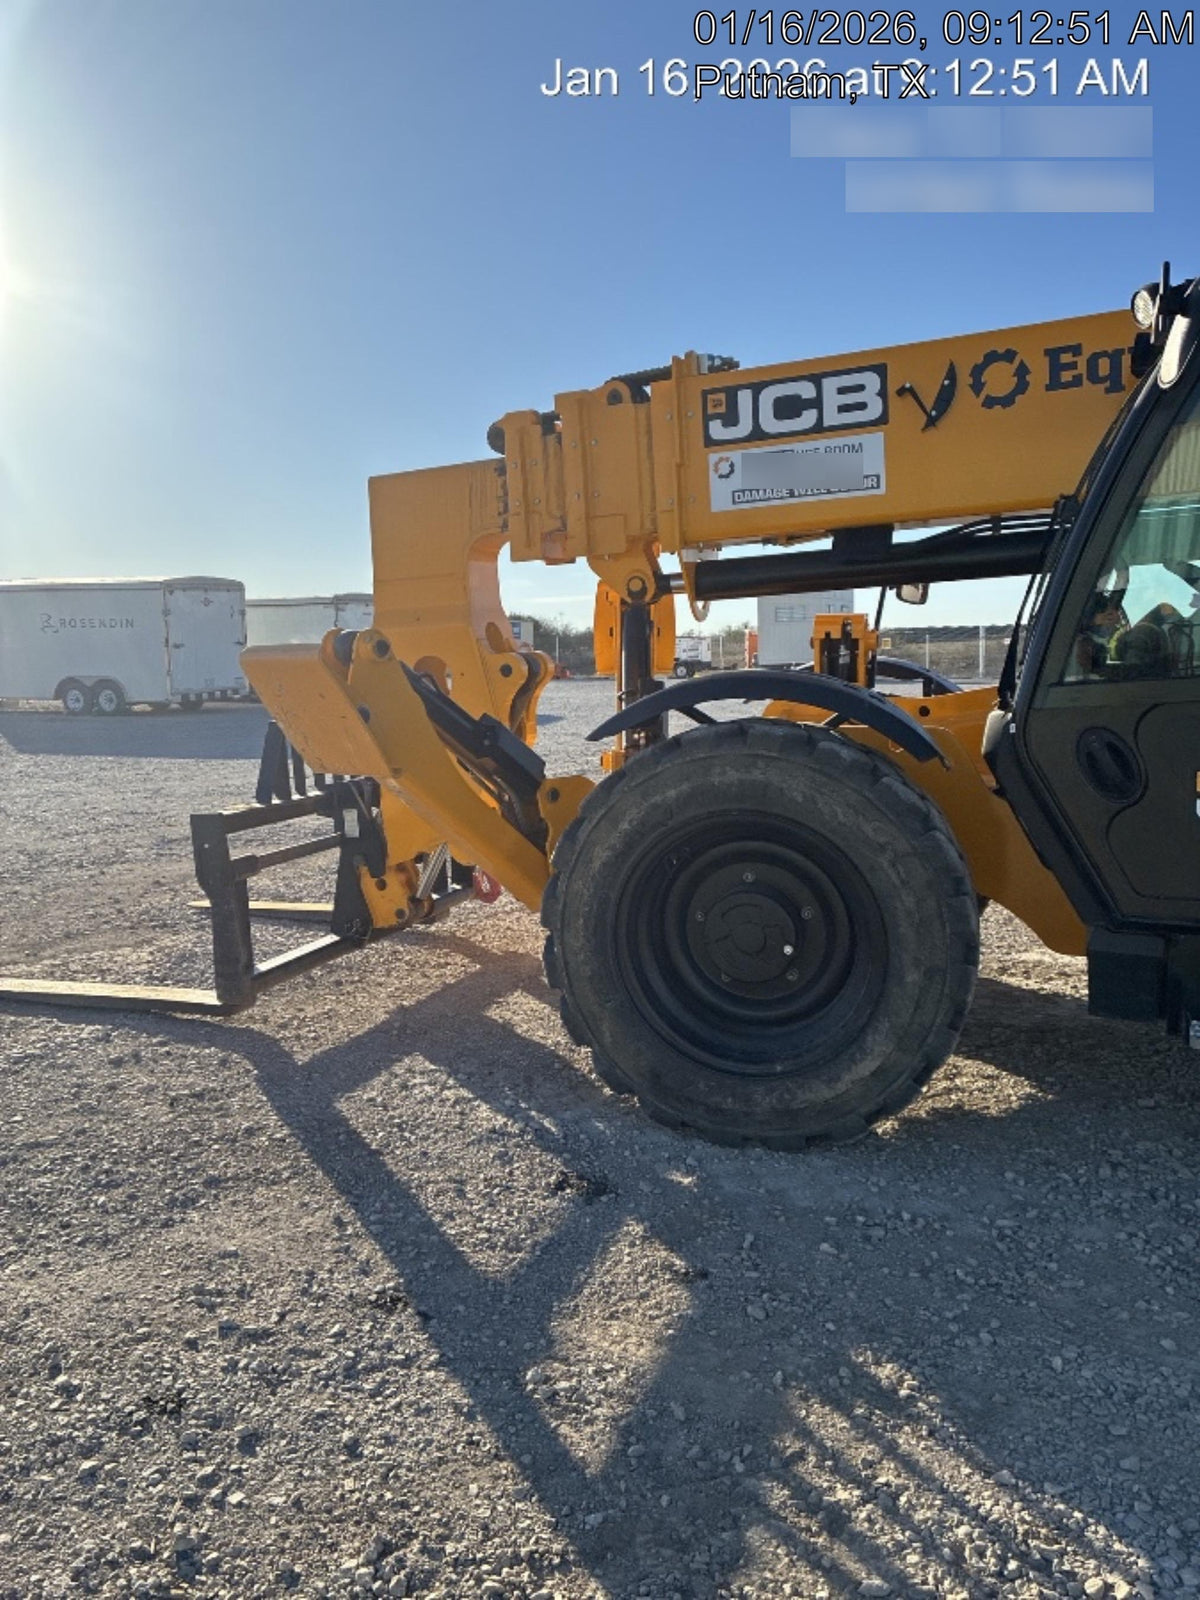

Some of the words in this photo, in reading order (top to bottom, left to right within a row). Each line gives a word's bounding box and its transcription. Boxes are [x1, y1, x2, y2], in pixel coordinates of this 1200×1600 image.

[1043, 342, 1135, 395] Eq
[708, 370, 883, 441] JCB
[734, 488, 790, 502] DAMAGE
[59, 617, 135, 629] ROSENDIN
